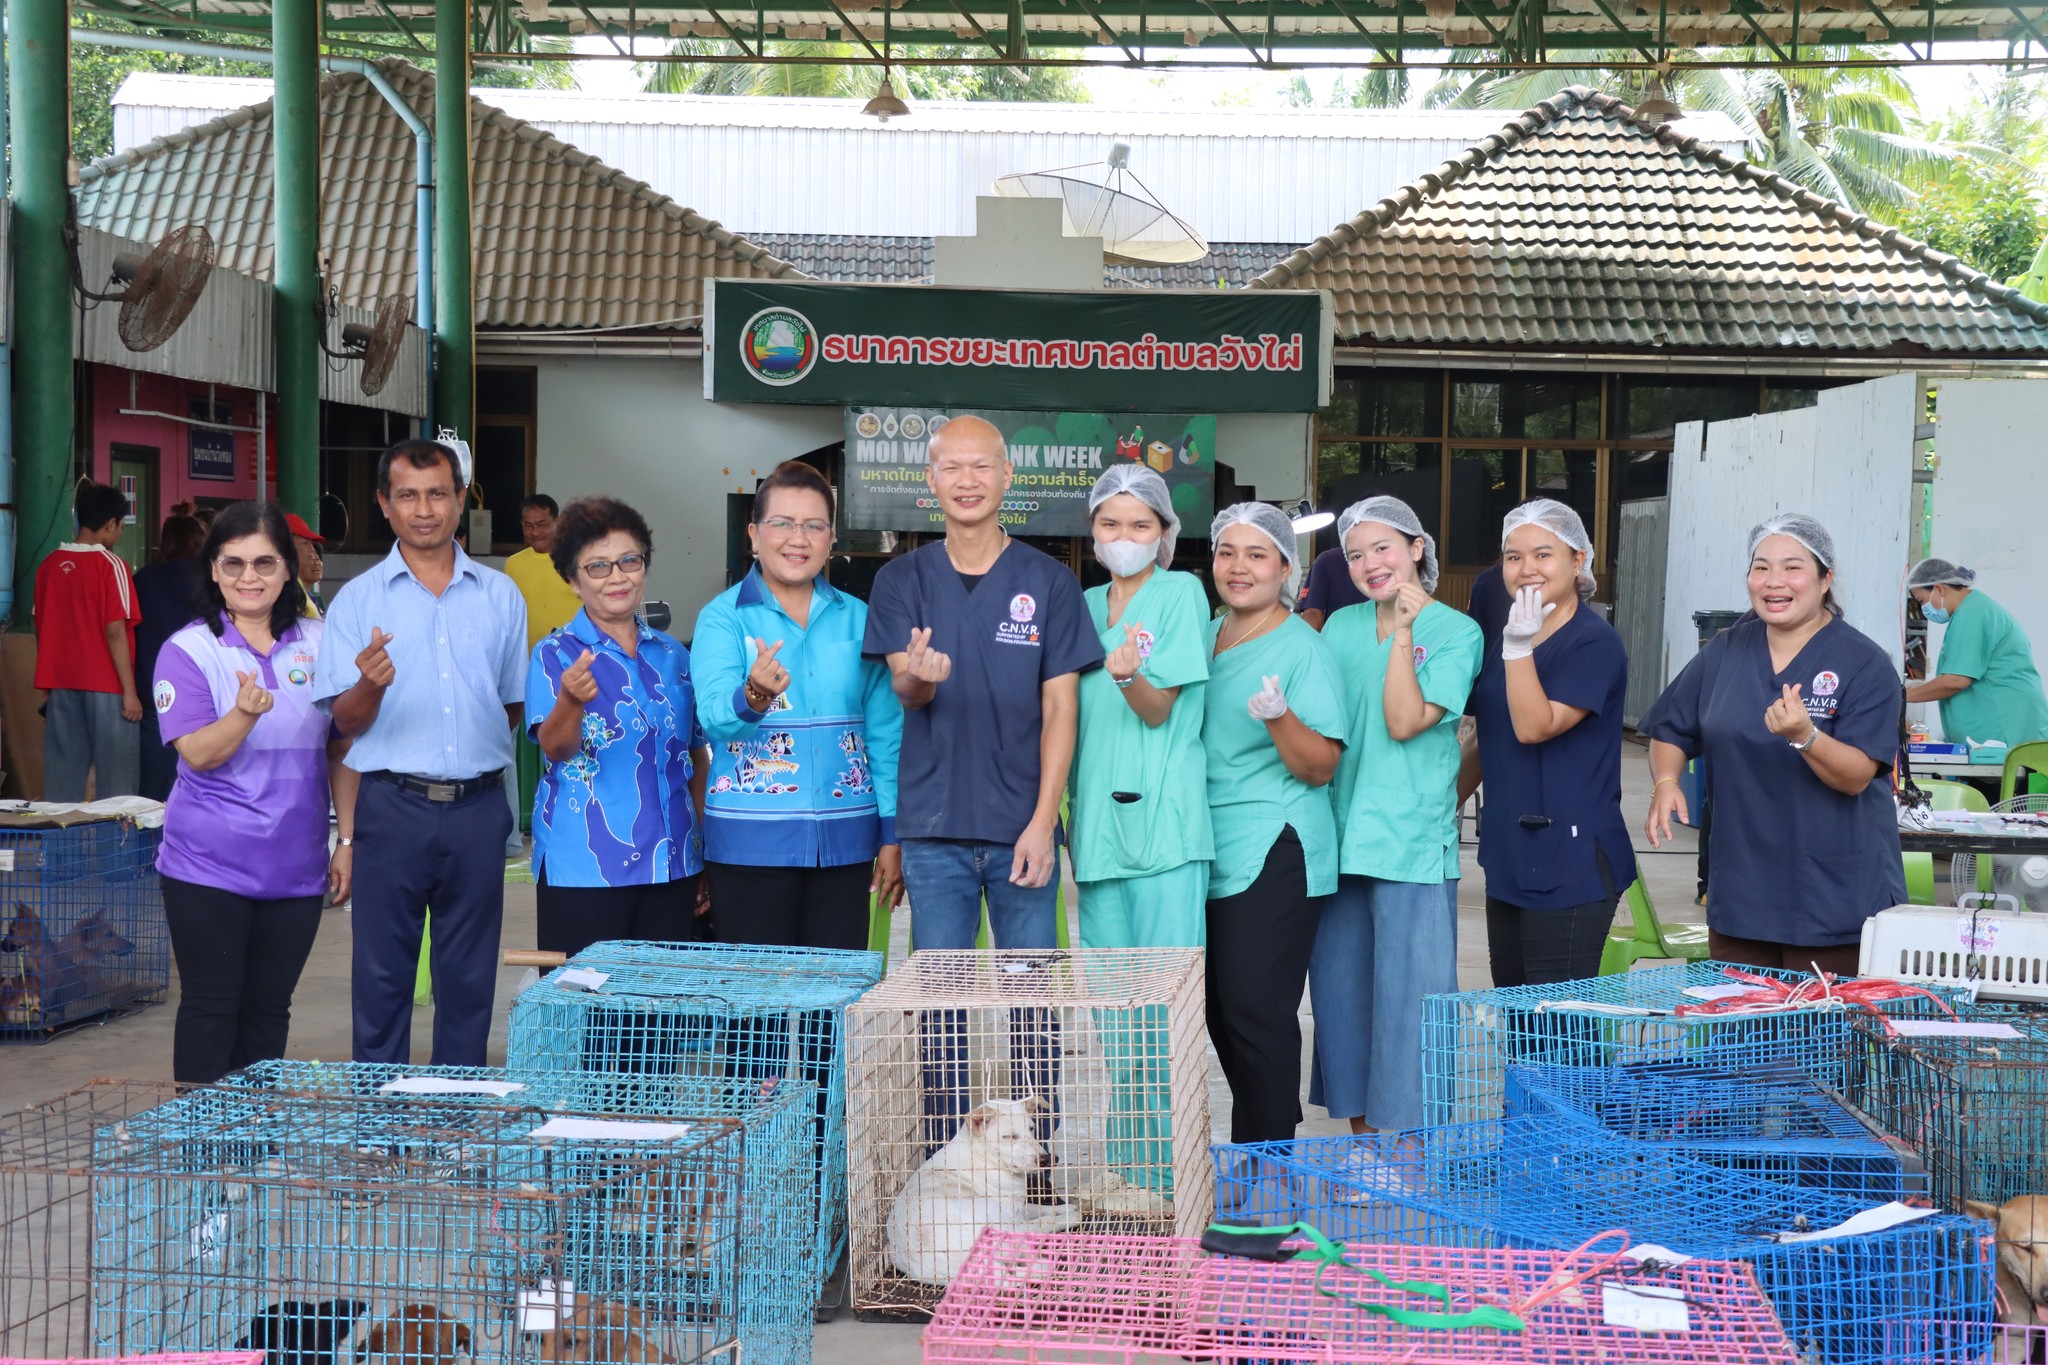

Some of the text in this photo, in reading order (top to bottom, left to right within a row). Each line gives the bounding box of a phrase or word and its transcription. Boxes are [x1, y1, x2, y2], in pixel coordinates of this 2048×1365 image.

[823, 332, 1303, 372] ธนาคารขยะเทศบาลตำบลวังไผ่
[857, 439, 898, 463] MOI
[1043, 445, 1103, 469] WEEK
[861, 467, 1096, 487] มหาดไทย ศความสำเร็จ
[1003, 488, 1086, 499] รปกครองส่วนท้องถิ่น
[999, 512, 1027, 525] วังไผ่
[999, 622, 1040, 635] C.N.V.R.
